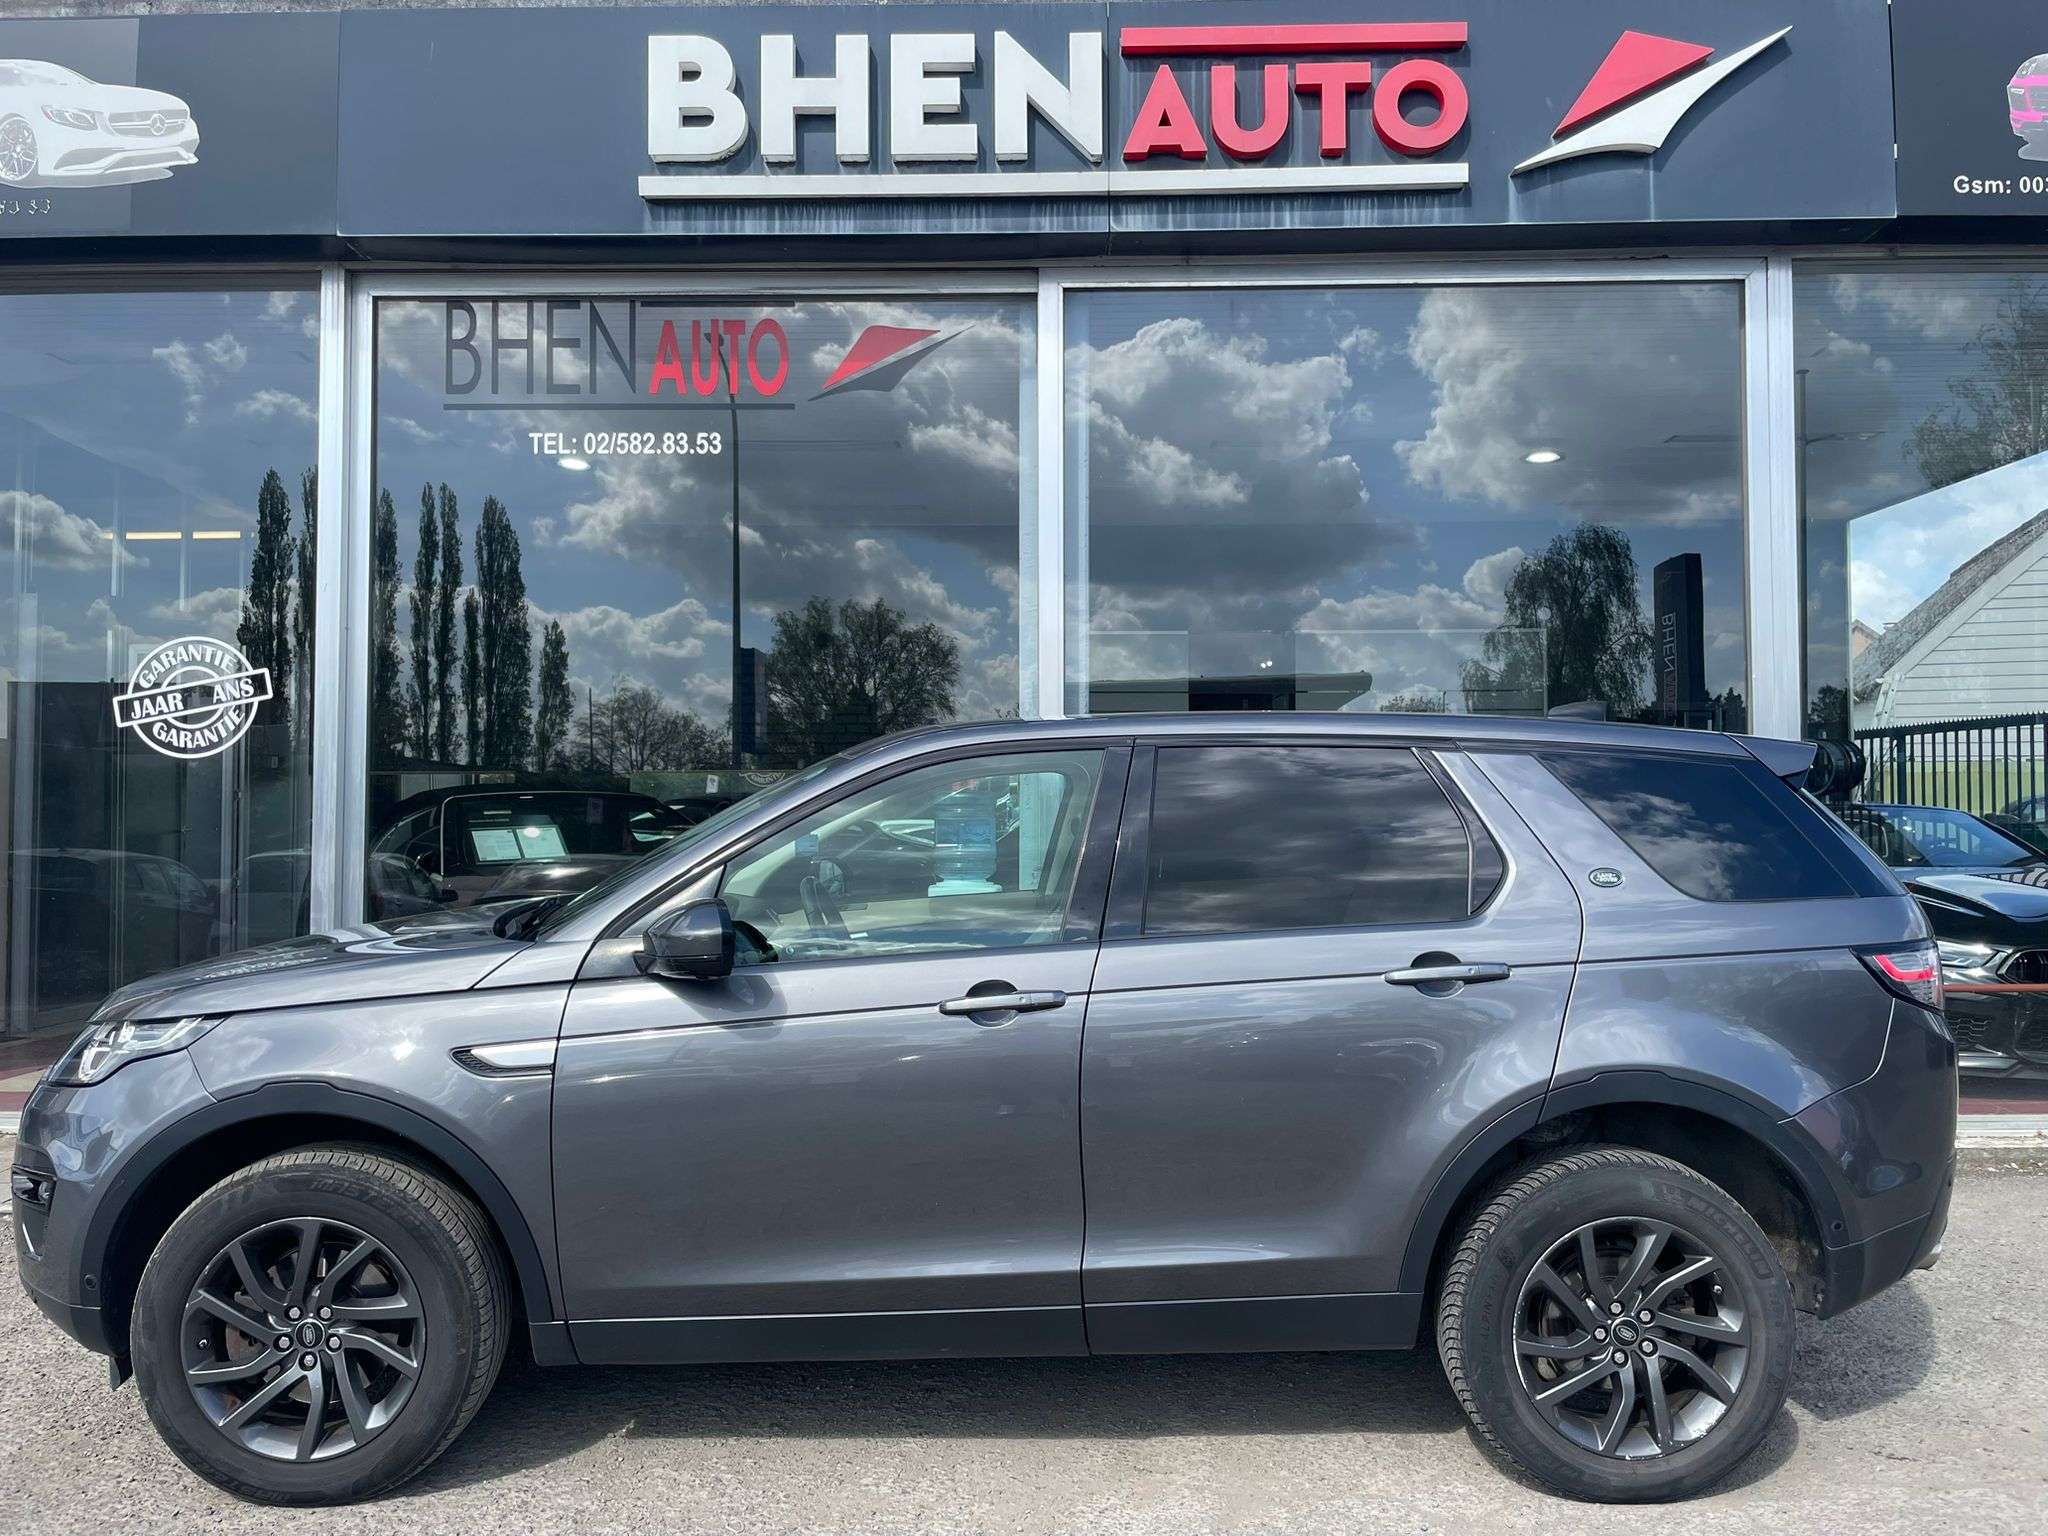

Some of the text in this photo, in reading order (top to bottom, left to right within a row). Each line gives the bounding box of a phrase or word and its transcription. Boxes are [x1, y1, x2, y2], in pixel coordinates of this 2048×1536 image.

[648, 31, 1469, 163] BHEN AUTO
[1953, 175, 2048, 194] Gsm: 00
[446, 300, 791, 397] BHEN AUTO
[529, 432, 723, 455] TEL: 02/582.83.53
[138, 644, 239, 689] GARANTIE
[131, 678, 255, 720] JAAR ANS
[152, 708, 246, 749] GARANTIE
